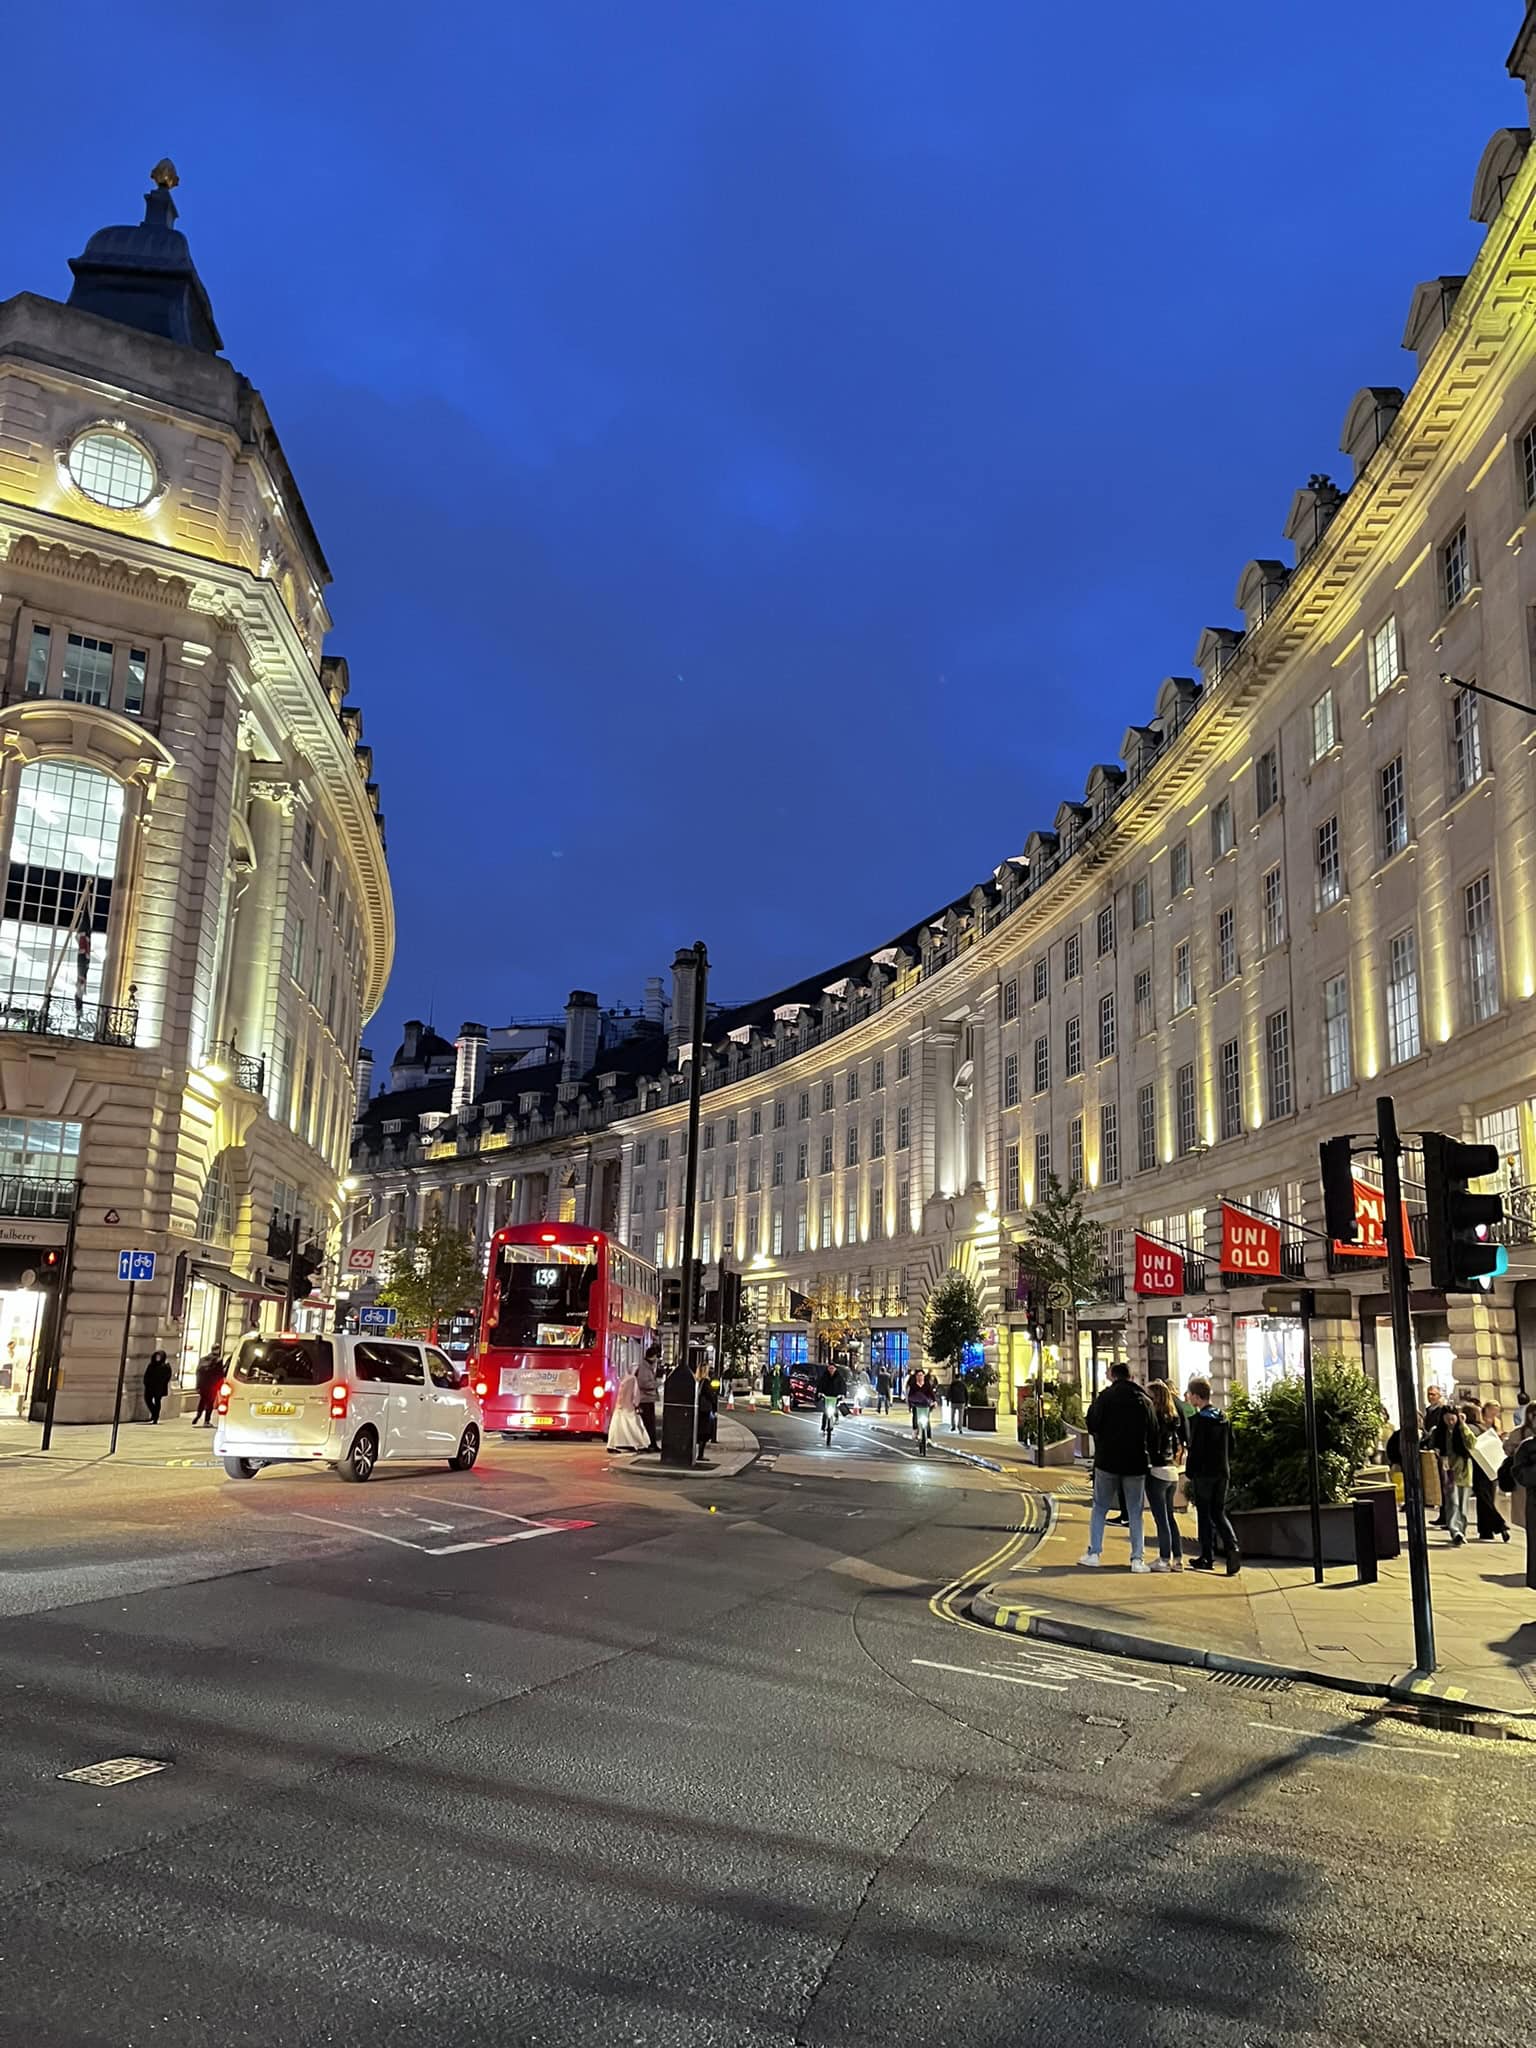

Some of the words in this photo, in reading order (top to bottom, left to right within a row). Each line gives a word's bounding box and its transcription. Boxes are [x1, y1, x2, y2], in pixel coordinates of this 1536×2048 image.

[1231, 1227, 1266, 1245] UNI
[351, 1251, 372, 1266] 66
[1143, 1254, 1171, 1270] UNI
[1231, 1248, 1269, 1267] QLO
[536, 1269, 557, 1285] 139
[1143, 1272, 1174, 1288] QLO
